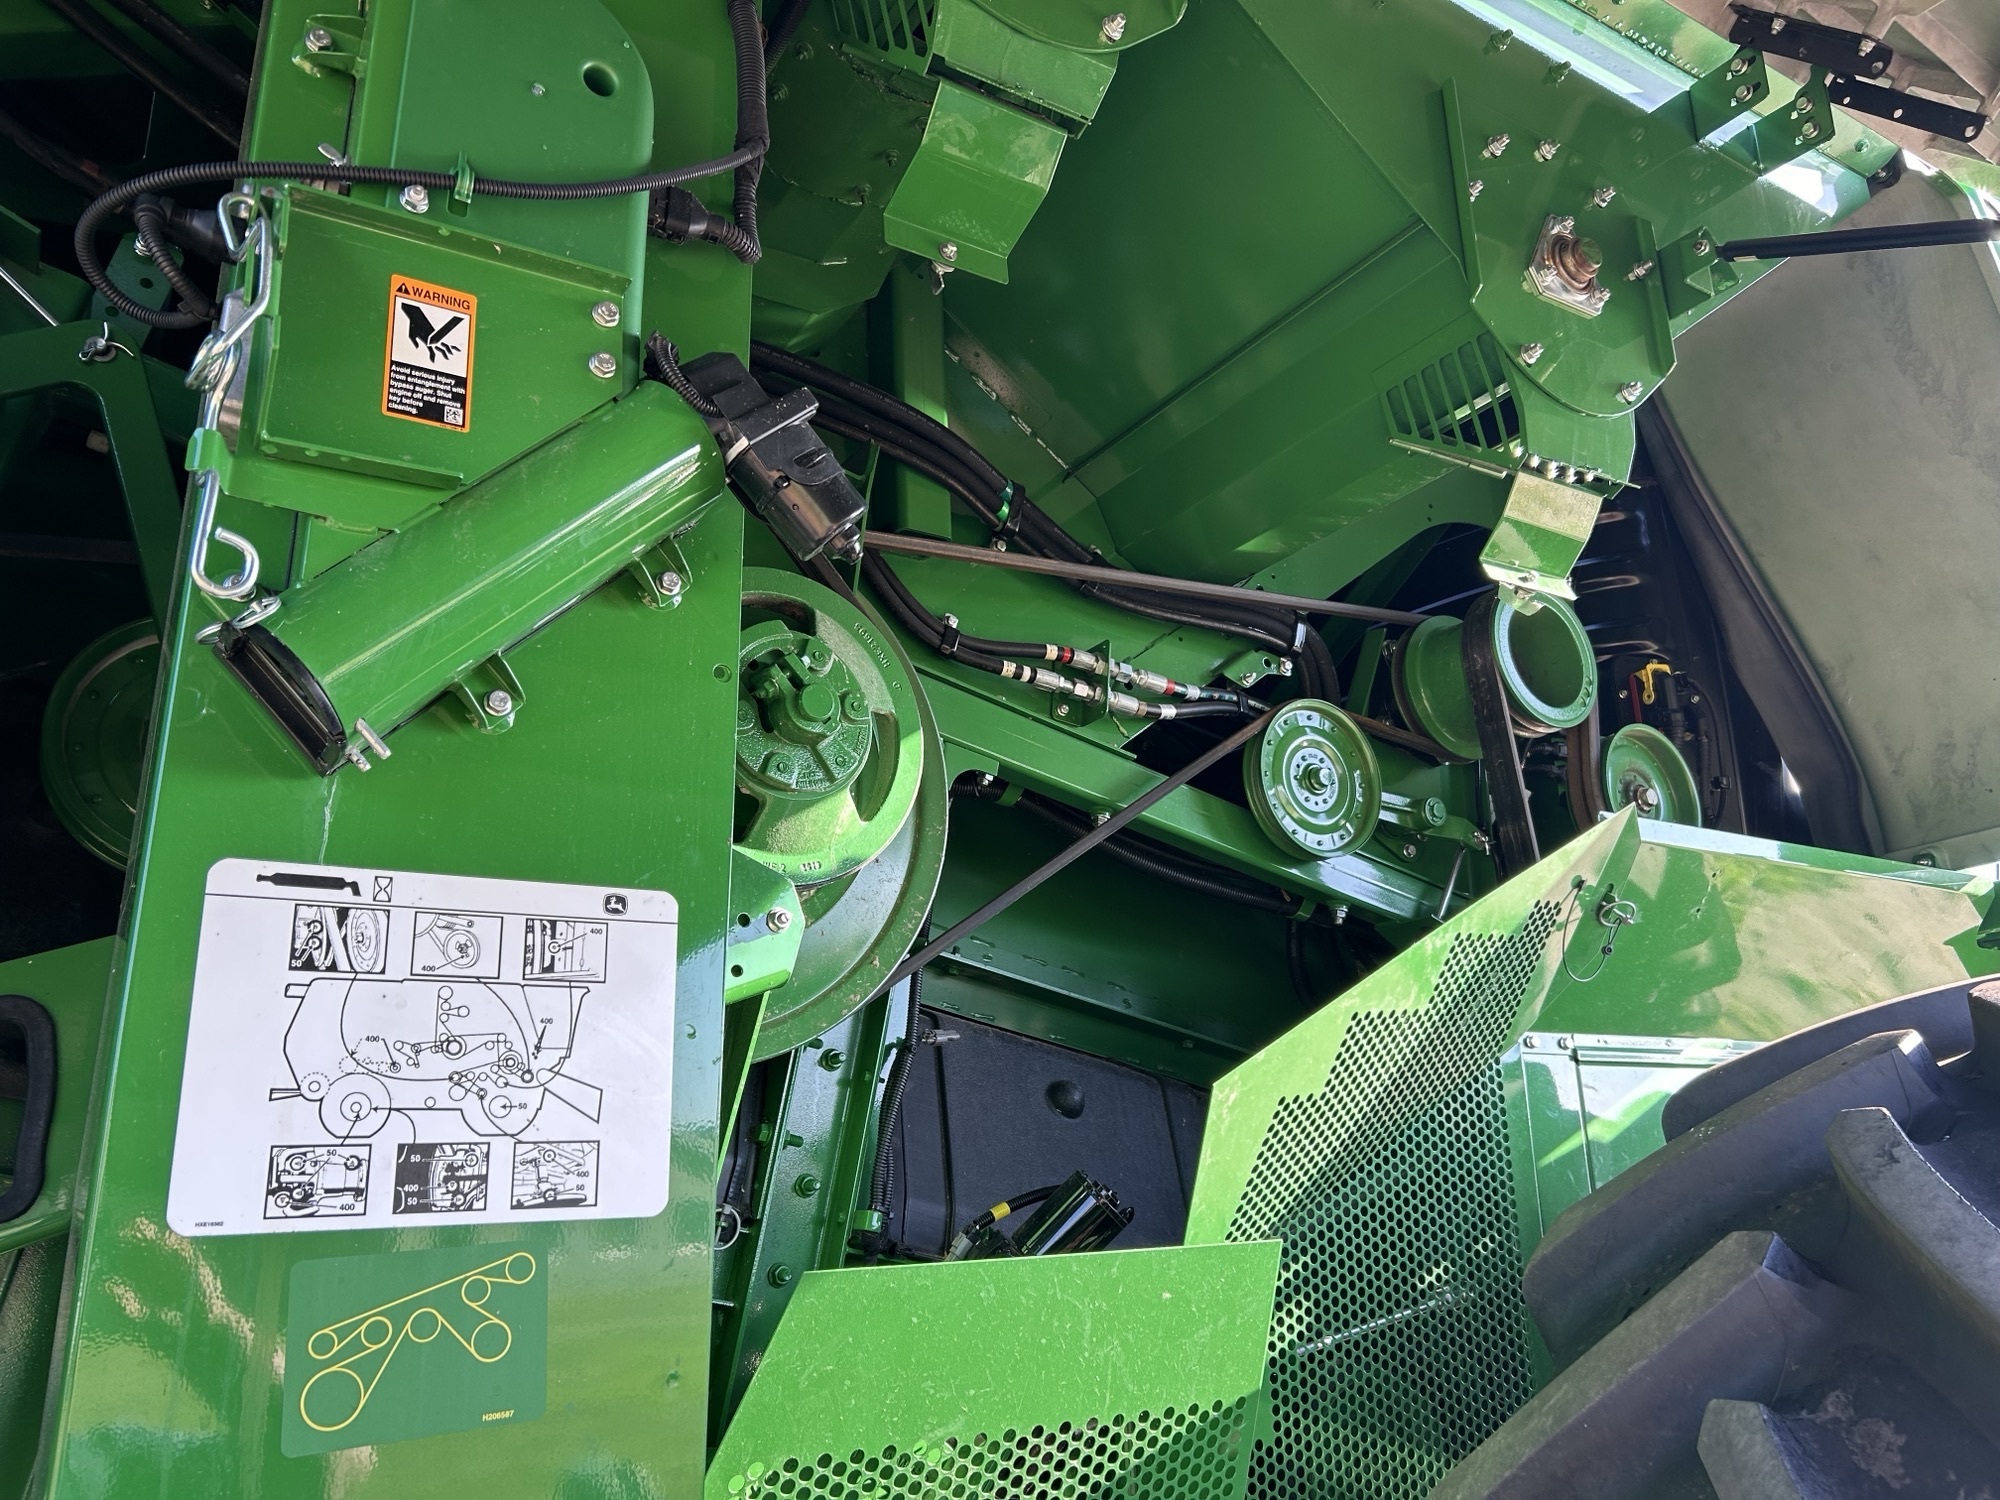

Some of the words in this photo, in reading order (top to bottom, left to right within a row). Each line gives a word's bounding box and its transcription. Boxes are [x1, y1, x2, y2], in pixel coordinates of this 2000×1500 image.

[412, 286, 470, 310] WARNING
[391, 364, 411, 374] Avoid
[411, 369, 436, 380] serious
[436, 375, 456, 386] injury
[390, 372, 407, 381] from
[407, 376, 451, 391] entanglement
[452, 387, 466, 395] with
[390, 379, 414, 391] bypass
[436, 389, 452, 399] Shut
[388, 394, 401, 403] key
[402, 397, 423, 407] before
[389, 387, 412, 398] engine
[412, 392, 423, 400] off
[423, 395, 436, 403] and
[436, 398, 461, 408] remove
[388, 402, 419, 415] cleaning.
[291, 959, 302, 968] 50
[540, 1017, 553, 1025] 400
[364, 1035, 380, 1043] 400
[518, 1102, 528, 1110] 50
[326, 1149, 337, 1157] 50
[410, 1154, 421, 1162] 50
[576, 1170, 590, 1178] 400
[403, 1184, 419, 1193] 400
[407, 1197, 417, 1206] 50
[339, 1203, 355, 1211] 400
[482, 1409, 515, 1422] H206587
